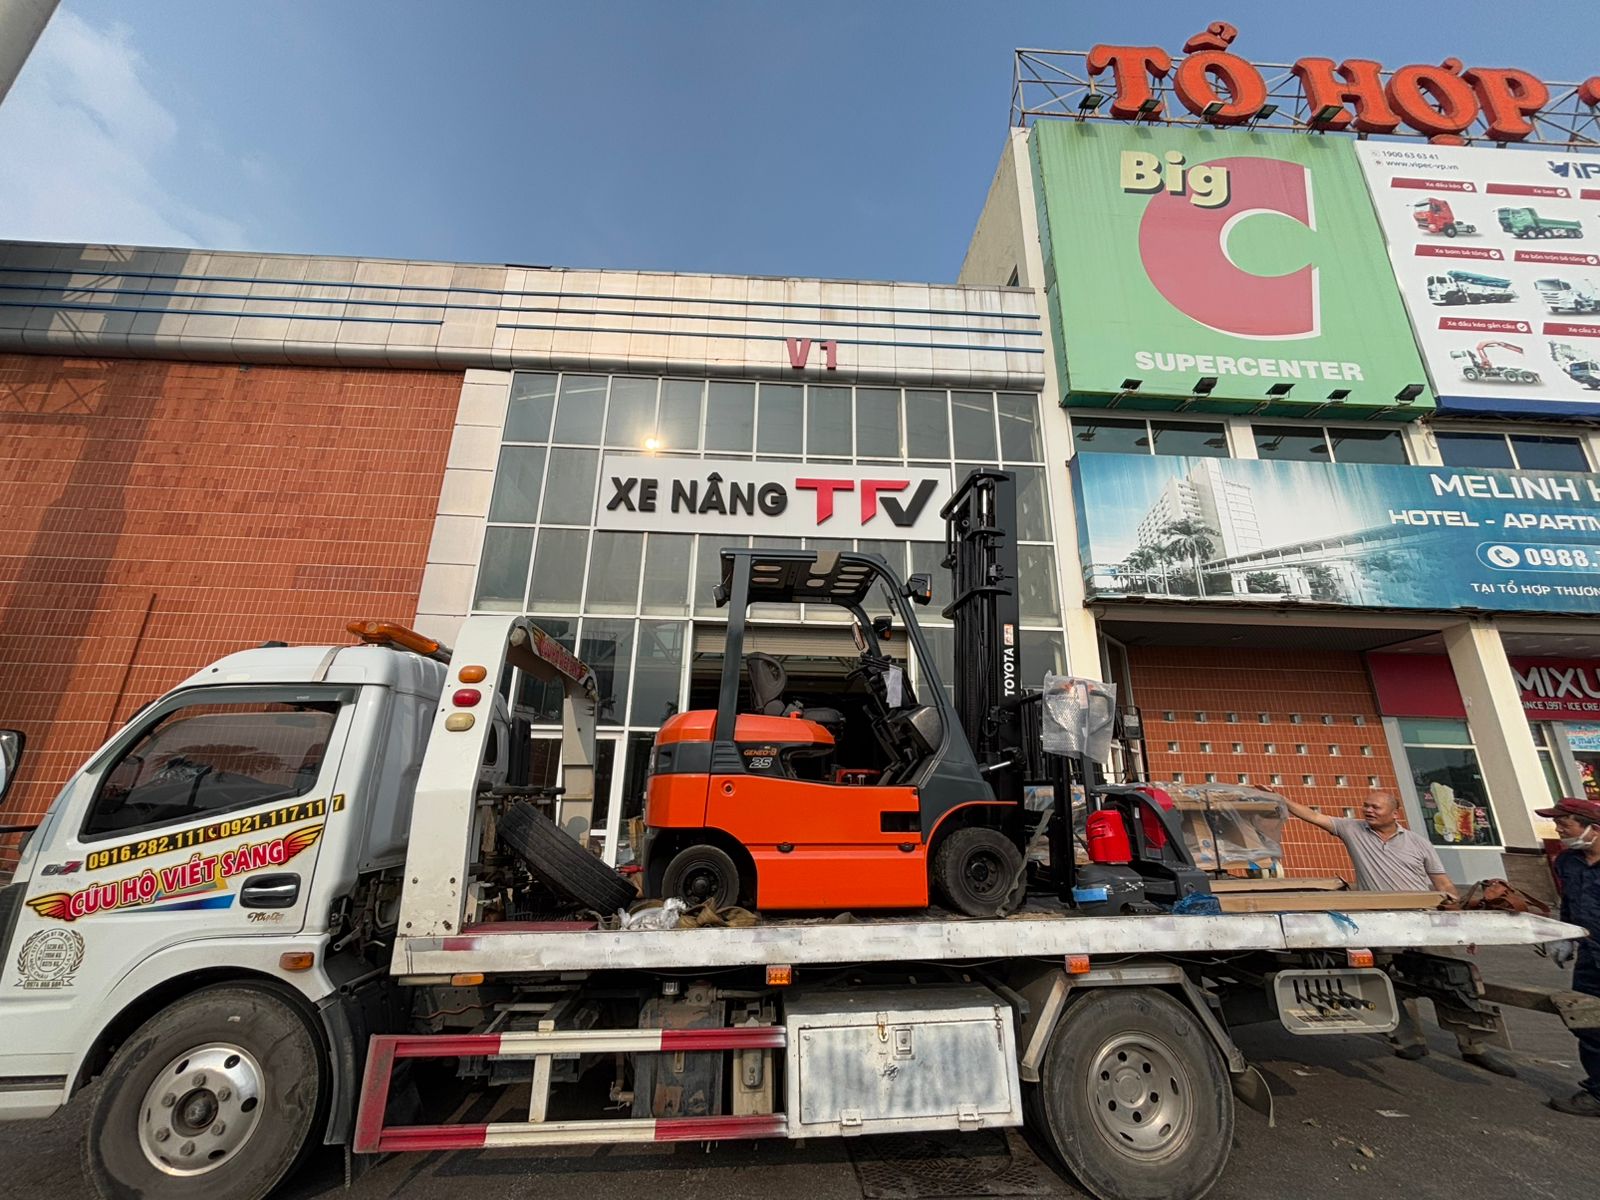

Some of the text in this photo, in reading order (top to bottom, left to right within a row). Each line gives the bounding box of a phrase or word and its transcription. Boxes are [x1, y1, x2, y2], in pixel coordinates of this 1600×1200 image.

[1086, 20, 1550, 147] TỔ HỢP
[1120, 151, 1231, 209] Big
[785, 337, 837, 370] V1
[1135, 351, 1364, 381] SUPERCENTER
[606, 476, 658, 513] XE
[670, 471, 788, 517] NÂNG
[1429, 473, 1581, 501] MELINH
[1388, 509, 1480, 527] HOTEL
[1470, 582, 1495, 596] TẠI
[1499, 579, 1518, 594] TỔ
[1520, 584, 1551, 596] HỢP
[1003, 648, 1016, 697] TOYOTA
[749, 756, 773, 768] 25
[88, 796, 342, 870] 0916.282.111 0921.117.117
[70, 882, 118, 917] CỨU
[121, 869, 157, 904] HỘ
